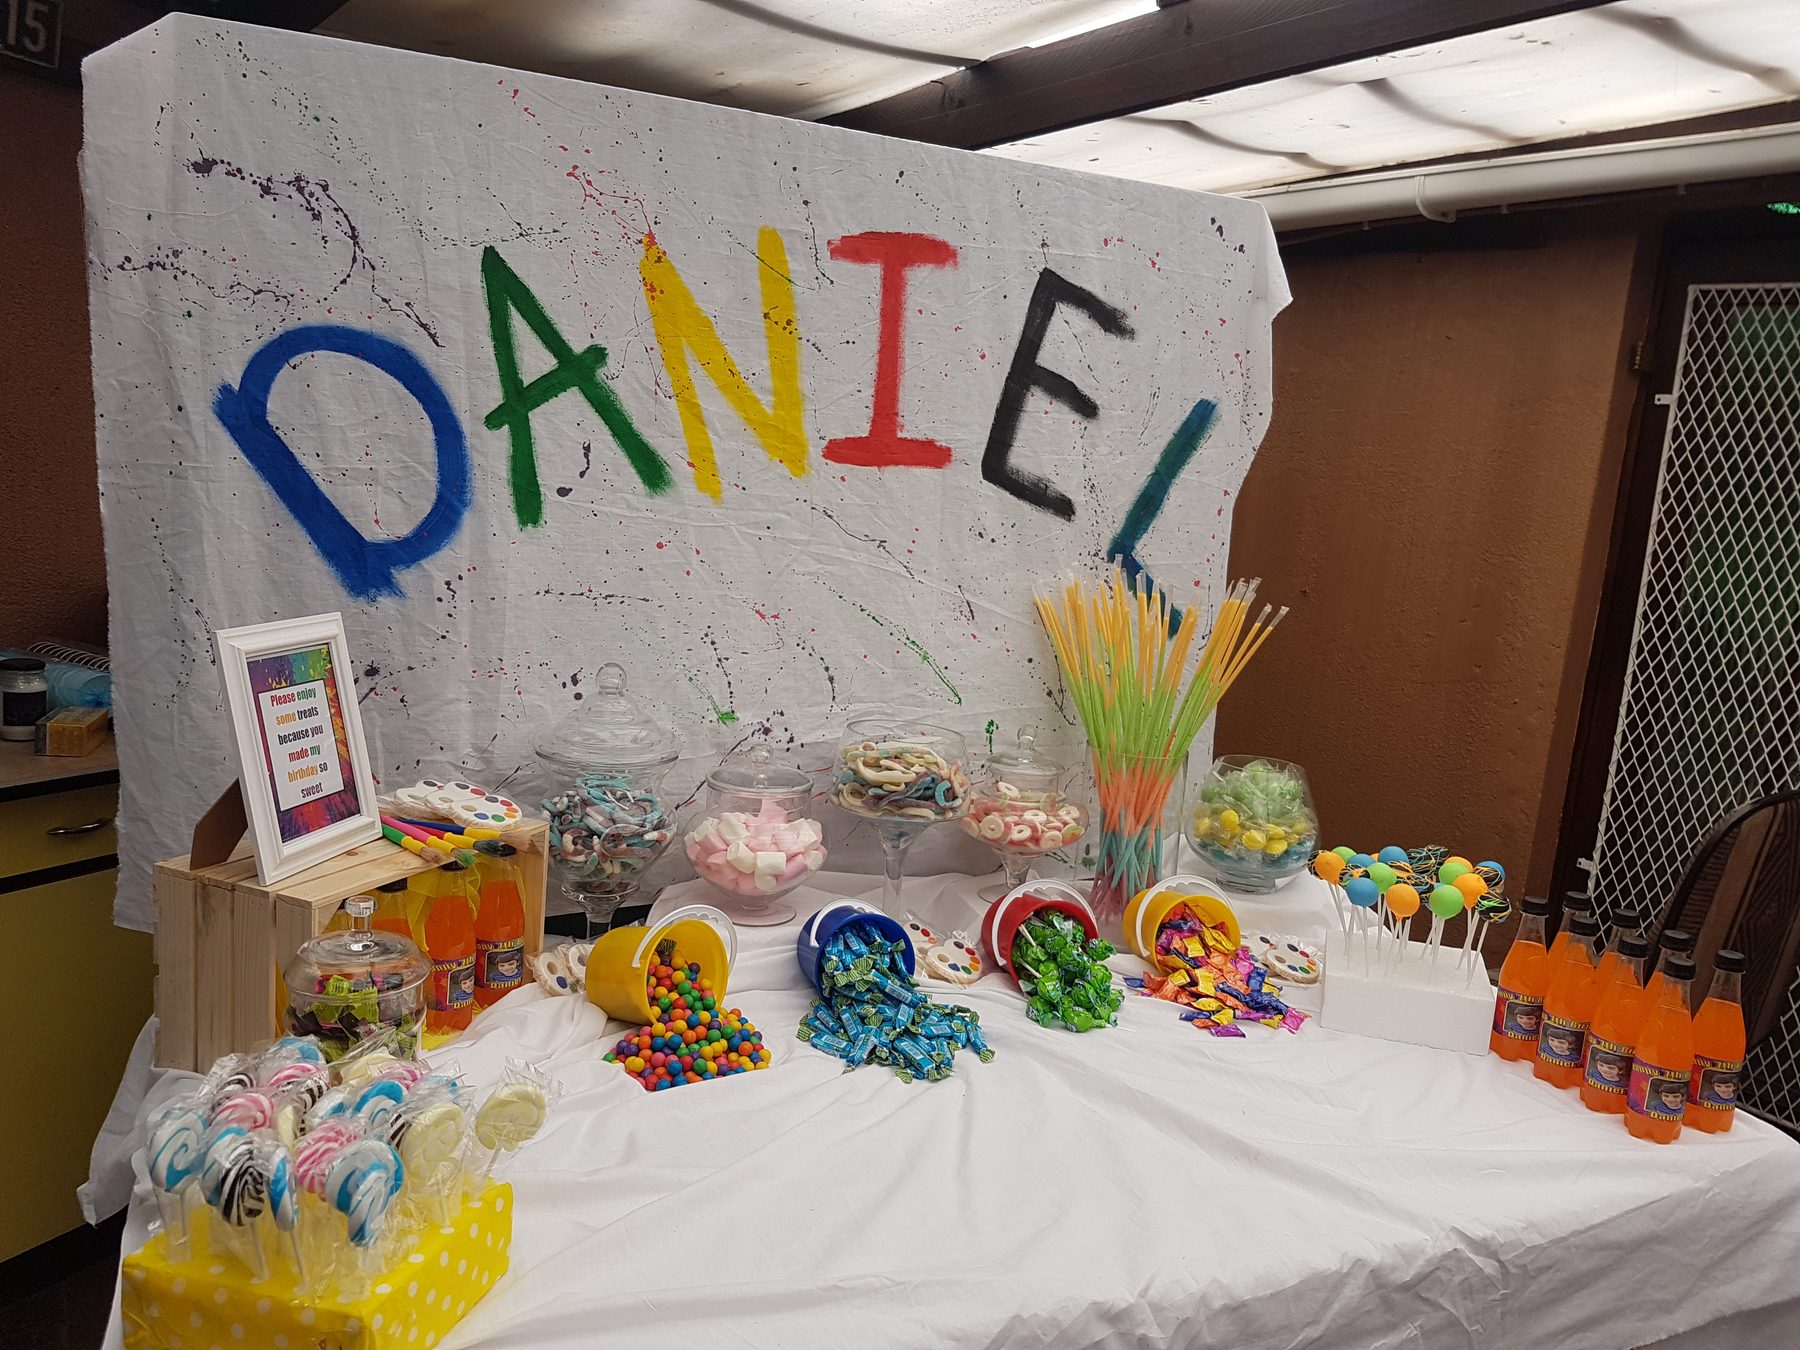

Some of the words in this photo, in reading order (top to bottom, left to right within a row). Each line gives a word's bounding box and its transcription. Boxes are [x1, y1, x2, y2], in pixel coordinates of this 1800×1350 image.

[213, 225, 1220, 640] DANIEL
[270, 692, 296, 707] Please
[296, 688, 316, 701] enjoy
[275, 712, 297, 726] some
[297, 706, 319, 720] treats
[277, 728, 310, 745] because
[309, 724, 324, 738] you
[288, 747, 310, 762] made
[309, 745, 321, 756] my
[287, 765, 319, 783] birthday
[318, 762, 328, 773] so
[300, 782, 324, 798] sweet
